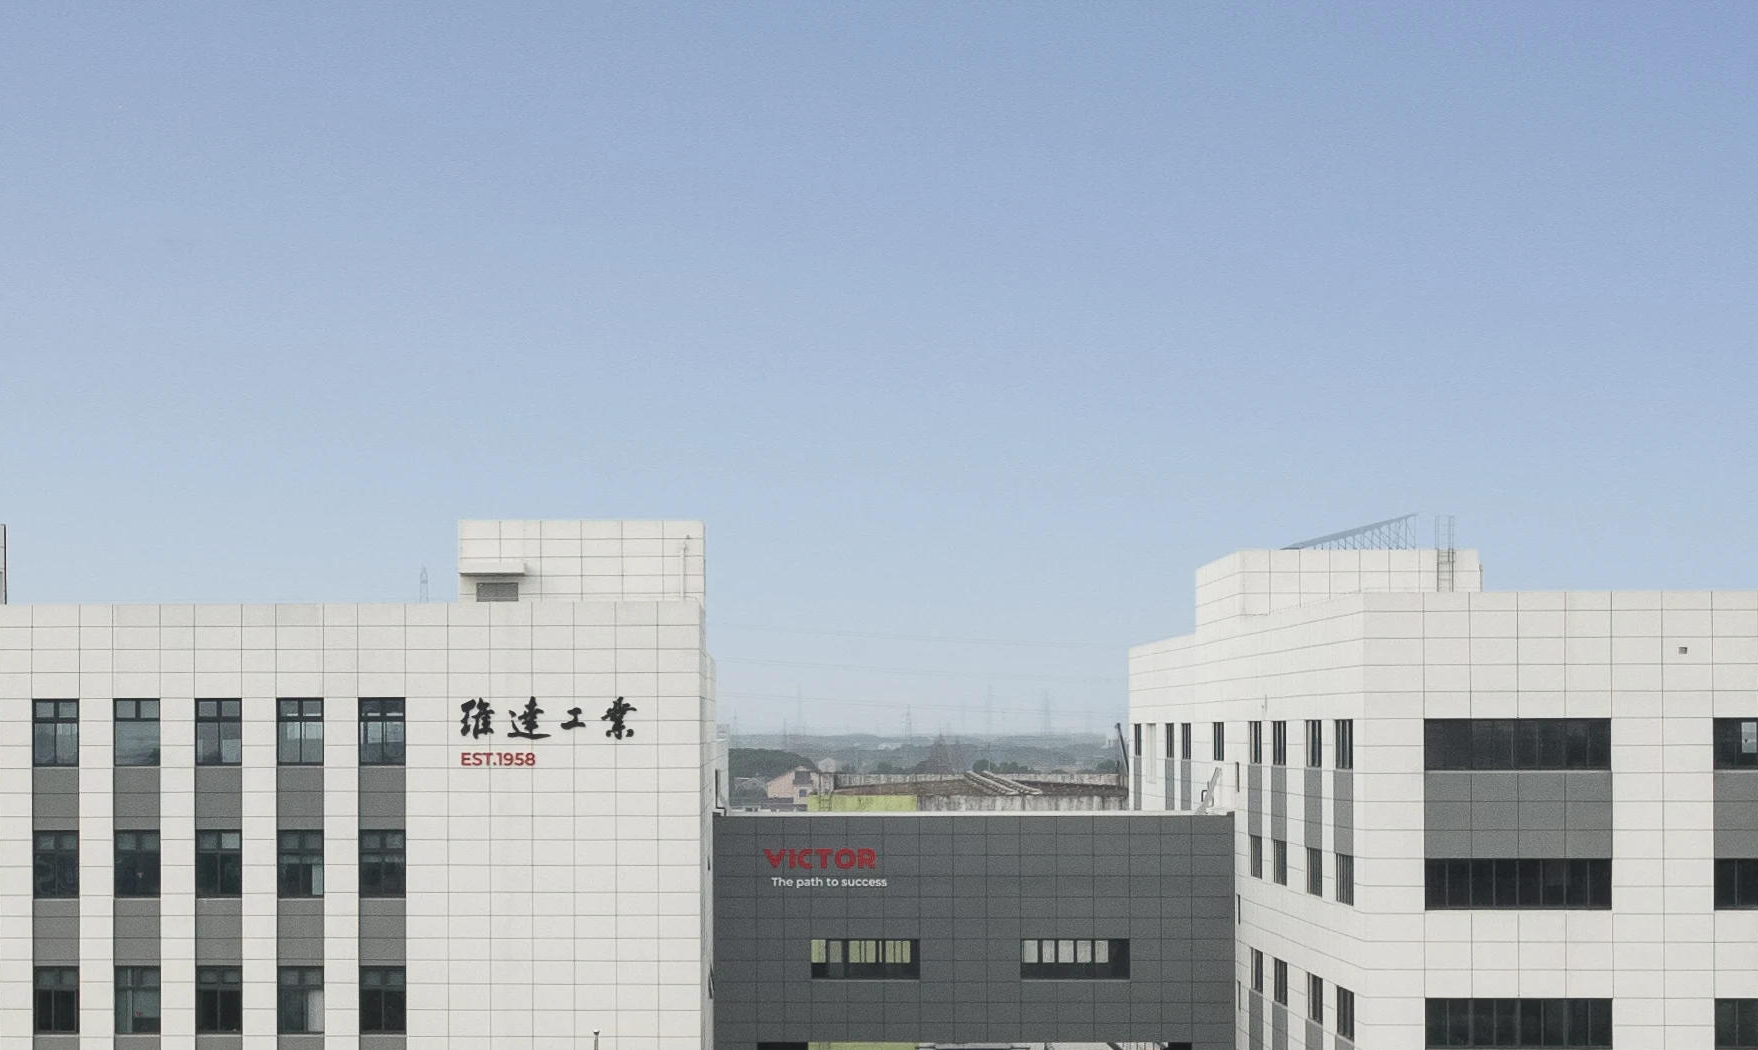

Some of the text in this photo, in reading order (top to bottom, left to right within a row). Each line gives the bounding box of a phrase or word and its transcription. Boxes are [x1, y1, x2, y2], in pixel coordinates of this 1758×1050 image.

[460, 752, 536, 766] EST.1958
[763, 848, 877, 869] VICTOR
[771, 877, 888, 889] The path to success
